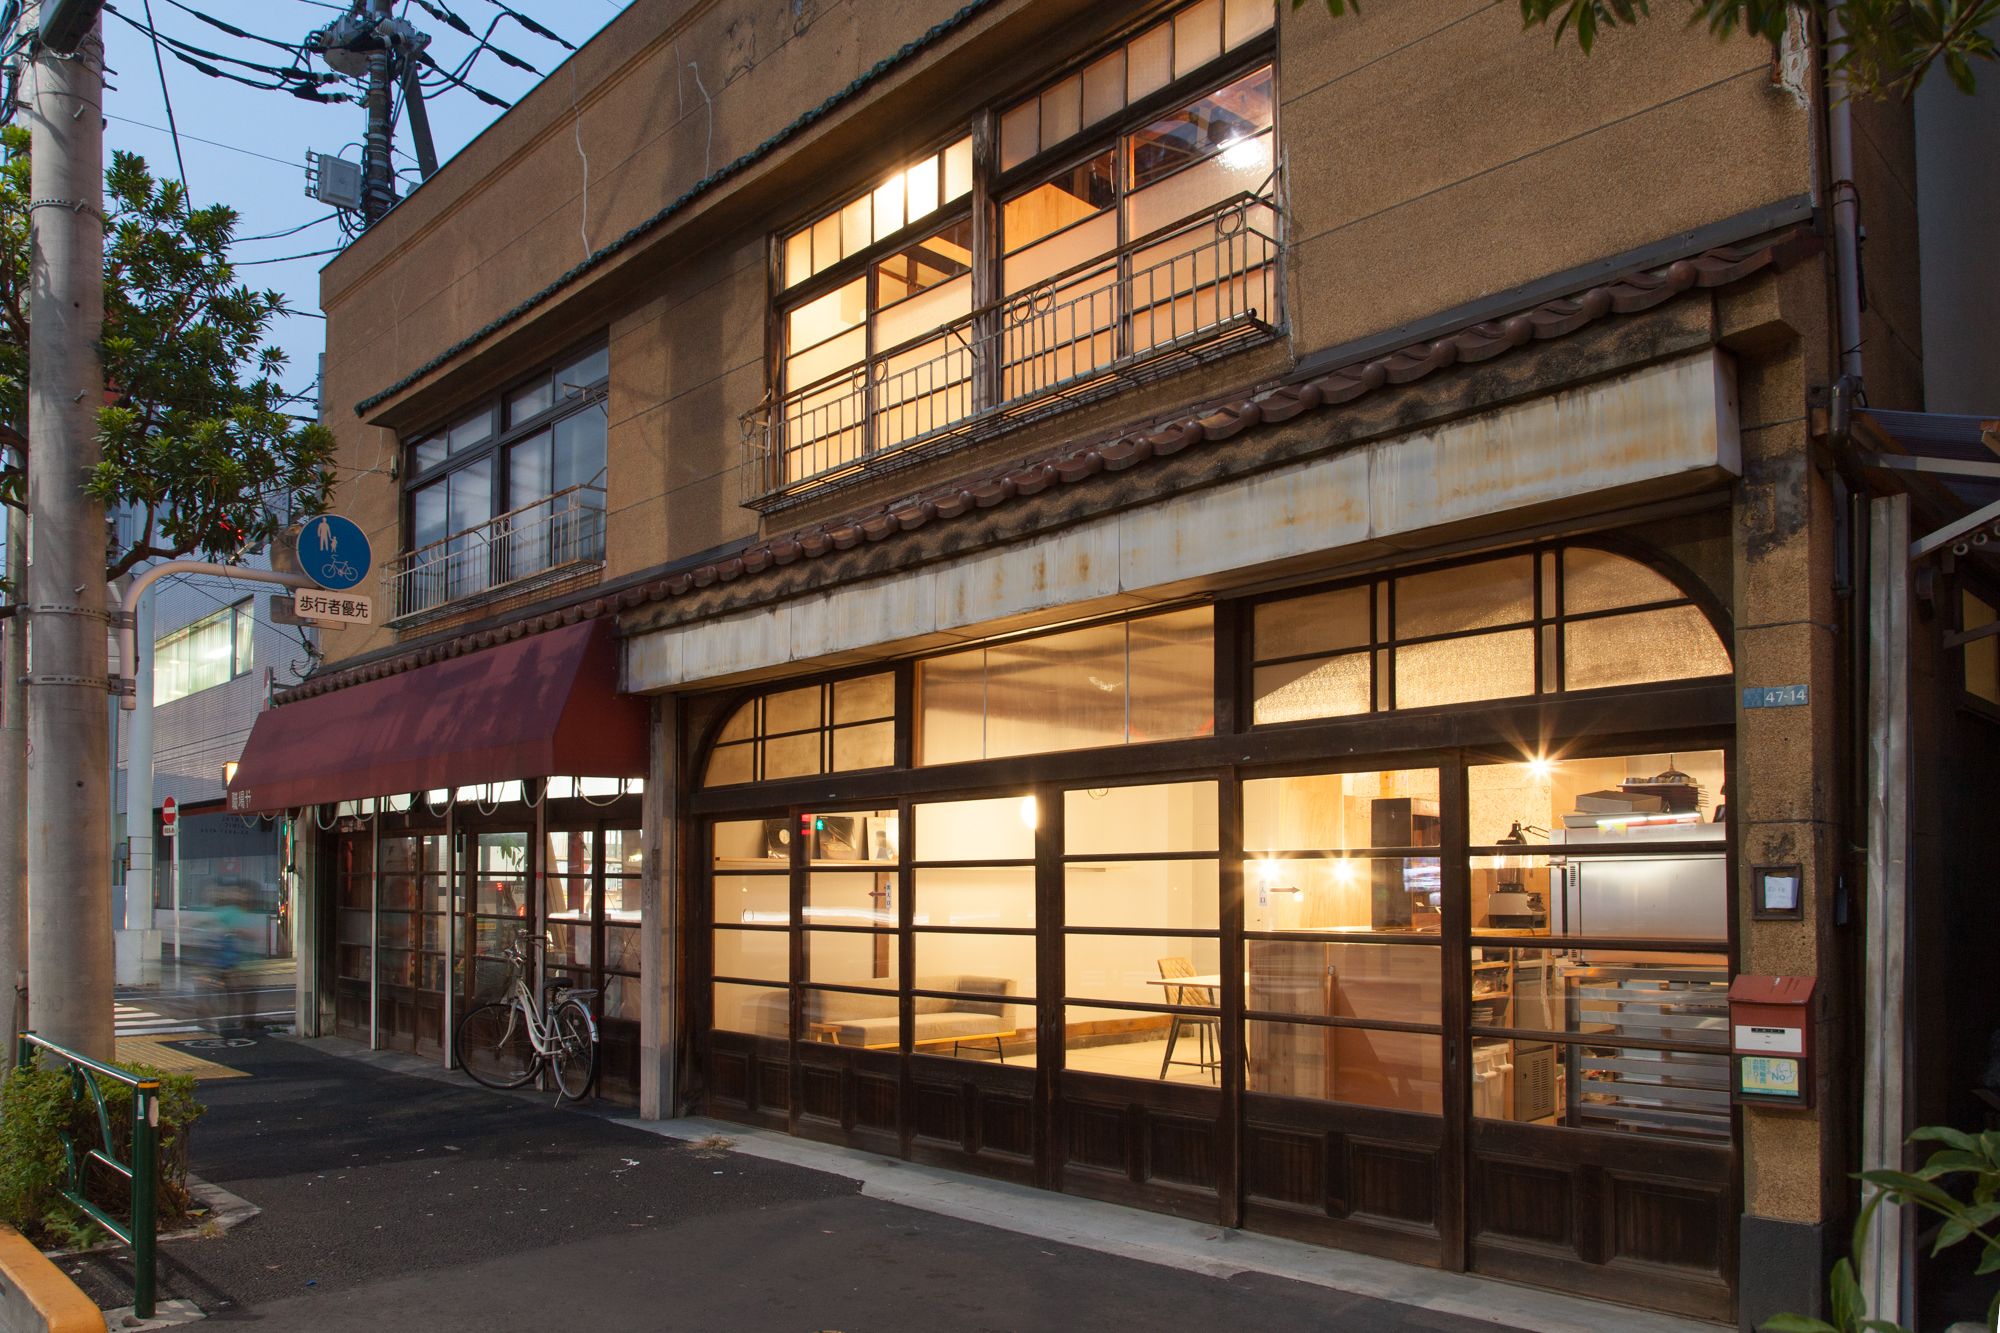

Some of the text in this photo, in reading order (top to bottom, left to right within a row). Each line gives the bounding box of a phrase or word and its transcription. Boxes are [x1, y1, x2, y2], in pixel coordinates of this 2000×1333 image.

[300, 596, 368, 618] 歩行者優先
[1765, 689, 1806, 703] 47-14
